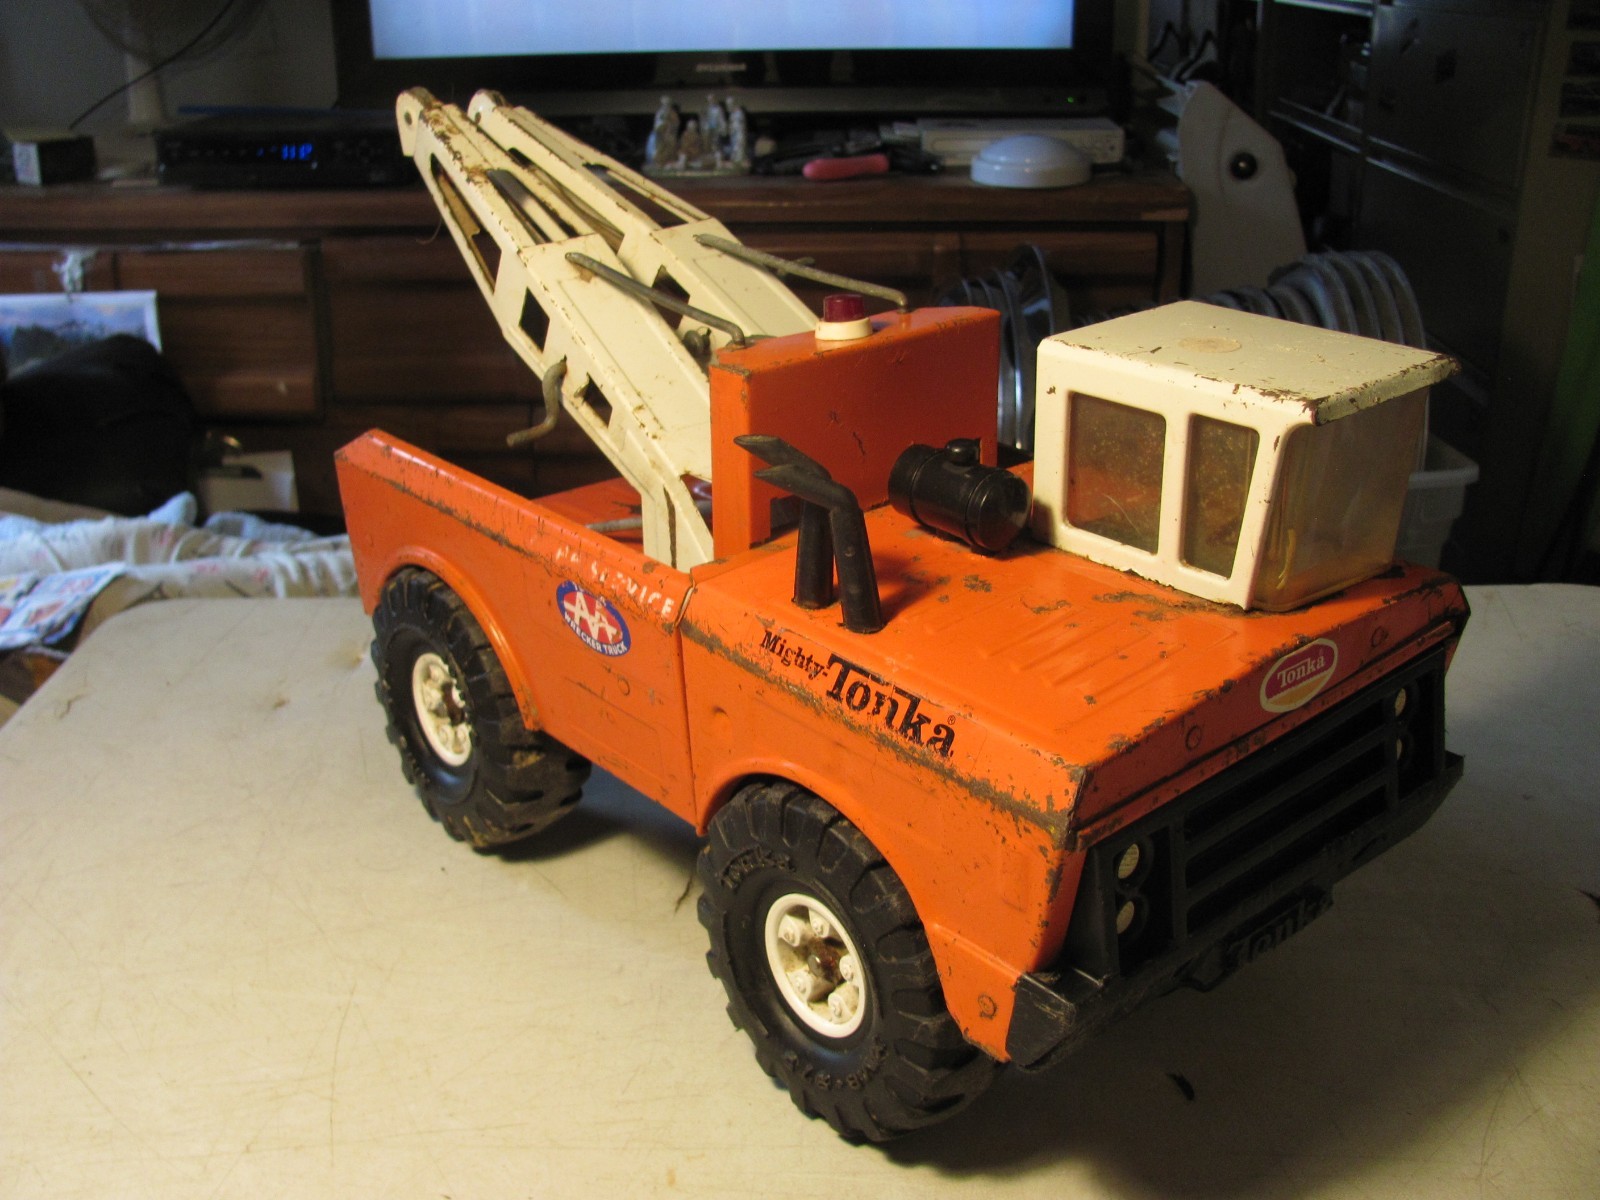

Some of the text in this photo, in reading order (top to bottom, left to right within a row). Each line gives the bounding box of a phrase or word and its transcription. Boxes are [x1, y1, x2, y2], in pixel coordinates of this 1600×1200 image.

[564, 611, 628, 655] WRECKER TRUCK
[1277, 656, 1325, 688] Tonka
[826, 652, 956, 758] Tonka
